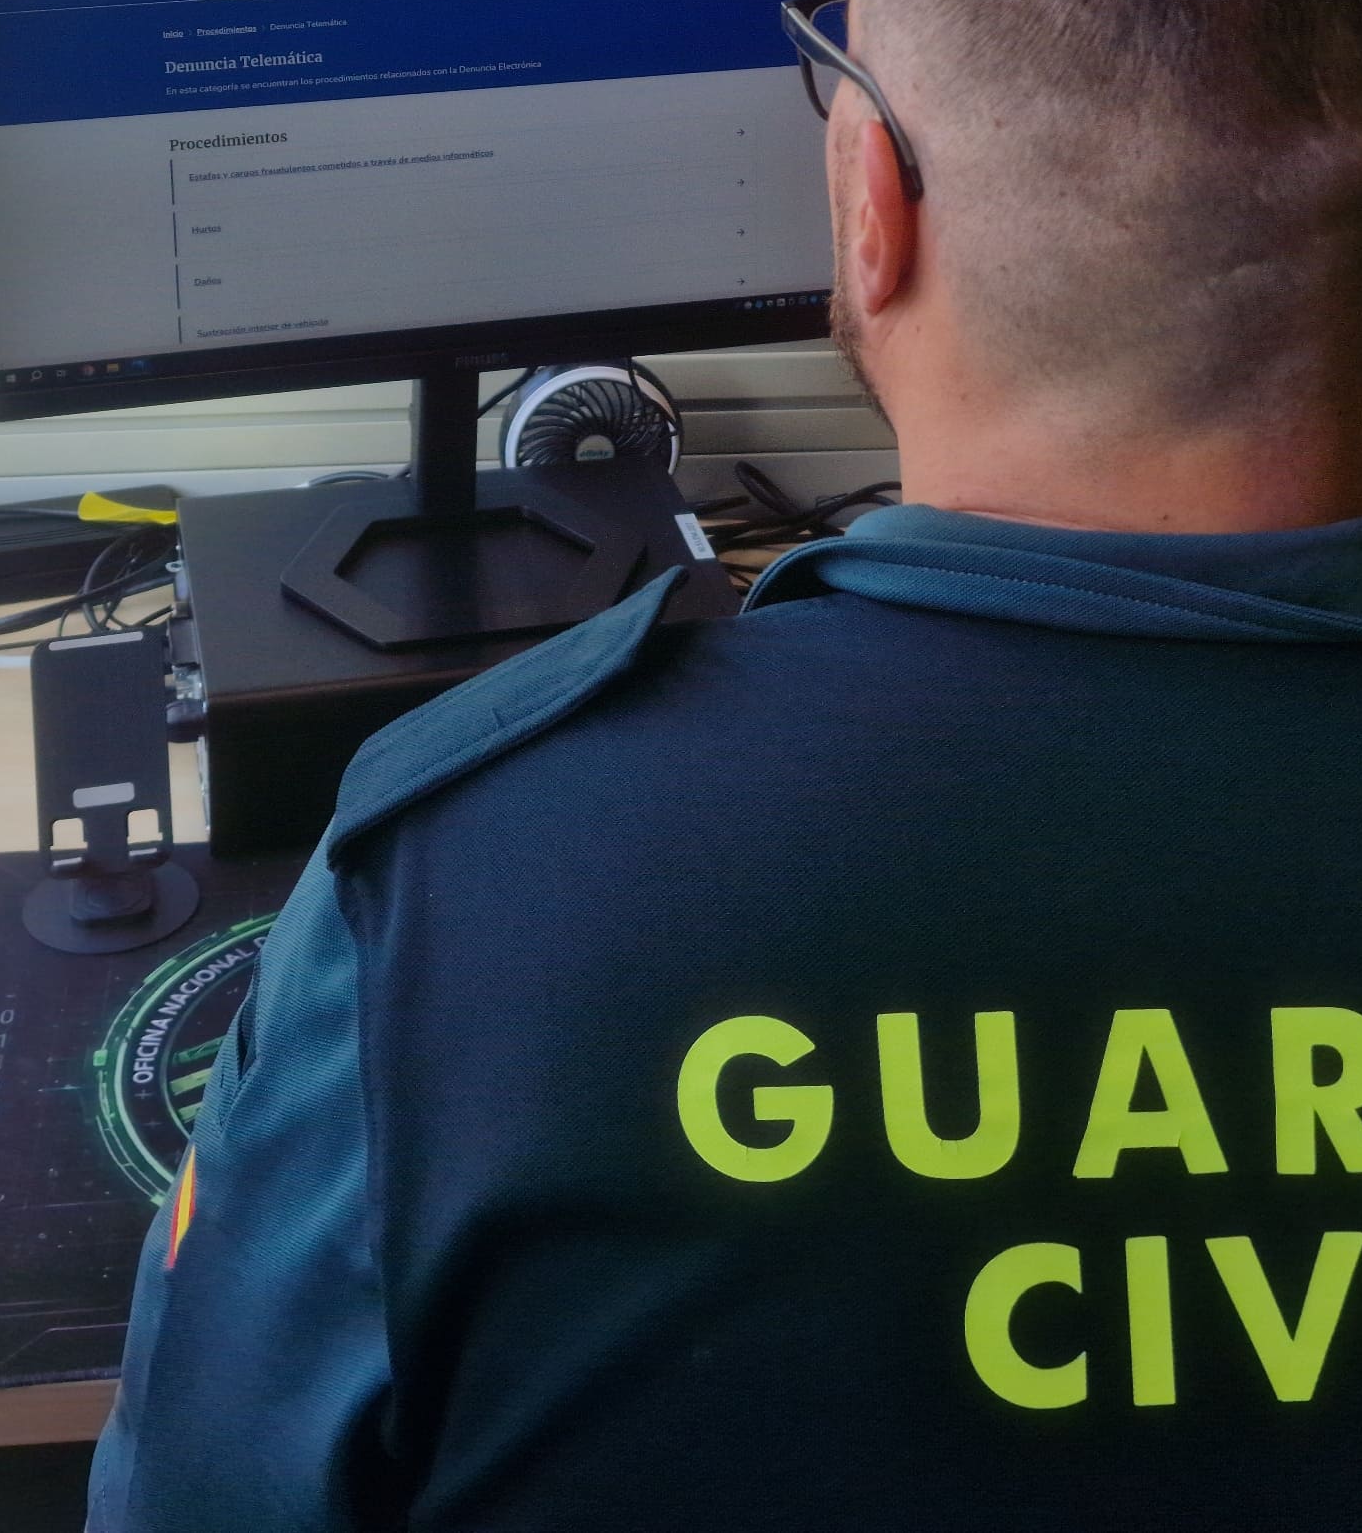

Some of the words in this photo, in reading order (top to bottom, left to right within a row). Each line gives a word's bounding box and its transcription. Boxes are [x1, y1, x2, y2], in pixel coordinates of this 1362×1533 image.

[196, 24, 258, 36] Procedimientos
[269, 21, 305, 31] Denuncia
[307, 18, 347, 29] Telemática
[162, 29, 184, 39] Inicio
[165, 57, 237, 74] Denuncia
[239, 50, 323, 68] Telemática
[165, 87, 177, 96] En
[179, 85, 197, 94] esta
[199, 82, 238, 94] categoría
[252, 79, 299, 89] encuentran
[300, 77, 314, 86] los
[315, 72, 378, 86] procedimientos
[379, 68, 431, 80] relacionados
[433, 68, 448, 76] con
[449, 66, 457, 74] la
[459, 63, 496, 73] Denuncia
[498, 59, 542, 71] Electrónica
[170, 131, 287, 151] Procedimientos
[189, 172, 220, 182] Estafas
[230, 170, 259, 179] cargos
[317, 160, 361, 172] cometidos
[370, 157, 397, 167] través
[398, 155, 409, 164] de
[411, 153, 440, 164] medios
[443, 149, 494, 161] informáticos
[191, 225, 222, 235] Hurtos
[193, 277, 222, 287] Daños
[197, 325, 246, 338] Sustracción
[248, 322, 278, 333] interior
[132, 1017, 174, 1084] OFICINA
[158, 948, 254, 1016] NACIONAL
